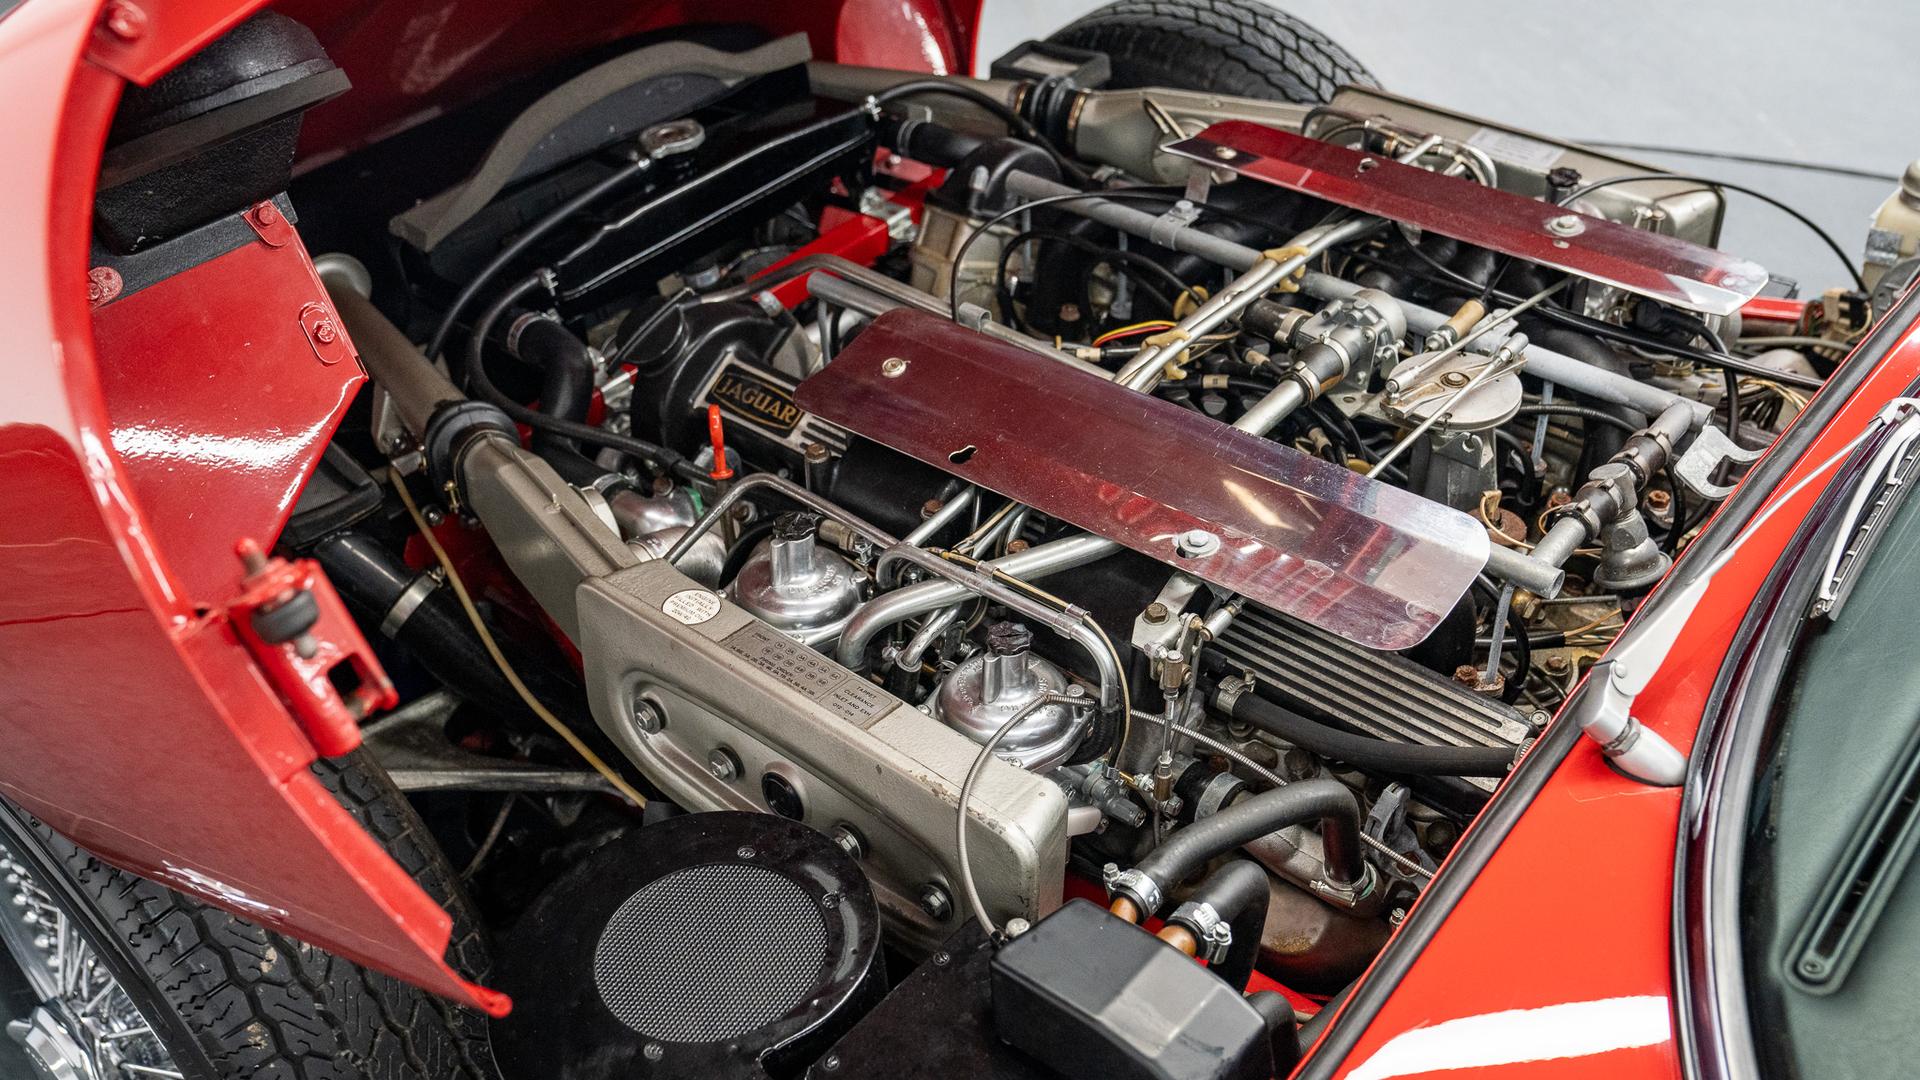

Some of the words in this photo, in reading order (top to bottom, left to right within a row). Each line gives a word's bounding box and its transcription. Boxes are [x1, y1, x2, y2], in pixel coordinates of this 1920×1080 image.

[716, 378, 797, 423] JAGUAR
[844, 690, 875, 708] CLEARANCE
[857, 686, 877, 698] TAPPET
[833, 693, 848, 703] INLET
[860, 707, 871, 716] EXH
